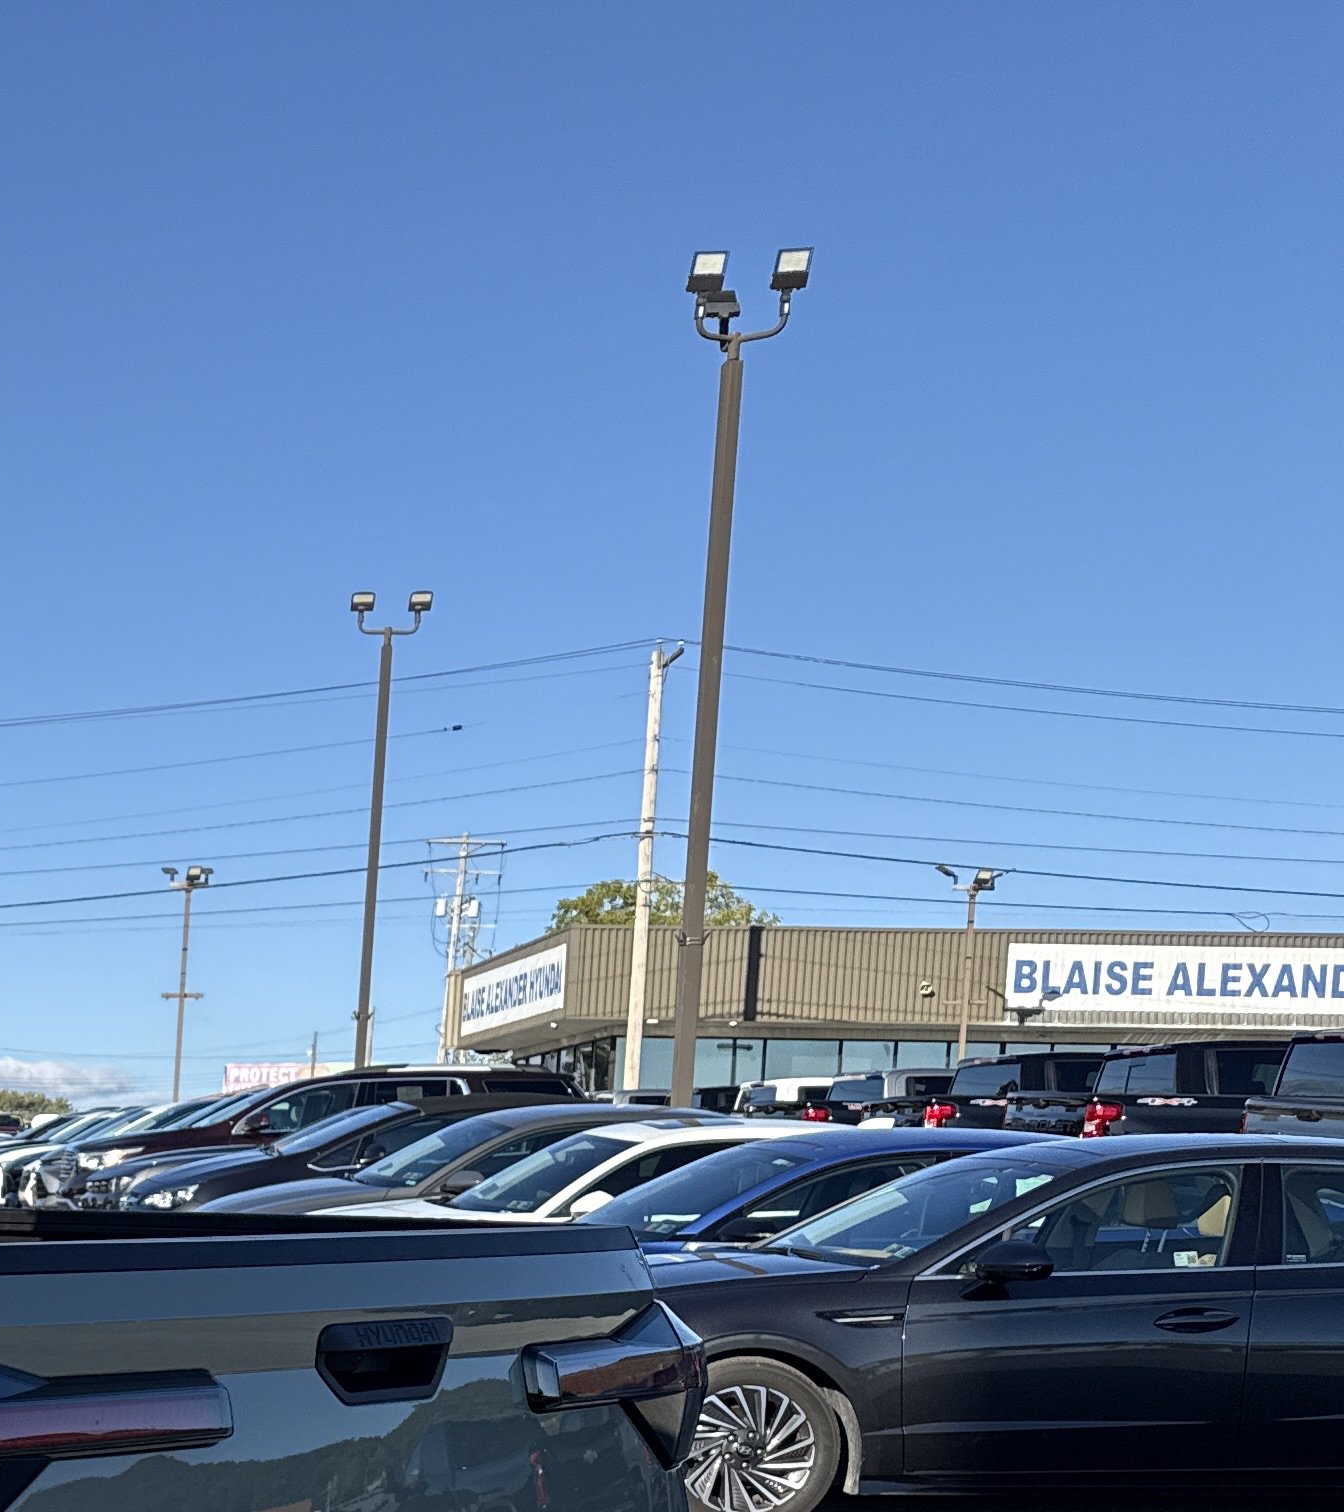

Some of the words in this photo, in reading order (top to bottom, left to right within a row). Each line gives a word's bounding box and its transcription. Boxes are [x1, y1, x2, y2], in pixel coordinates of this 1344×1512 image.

[462, 985, 486, 1022] BLAISE
[486, 971, 528, 1016] ALEXANDER
[528, 959, 563, 1004] HYUNDAI
[1012, 959, 1155, 996] BLAISE
[229, 1067, 298, 1083] PROTECT
[354, 1322, 441, 1347] HYUNDAI
